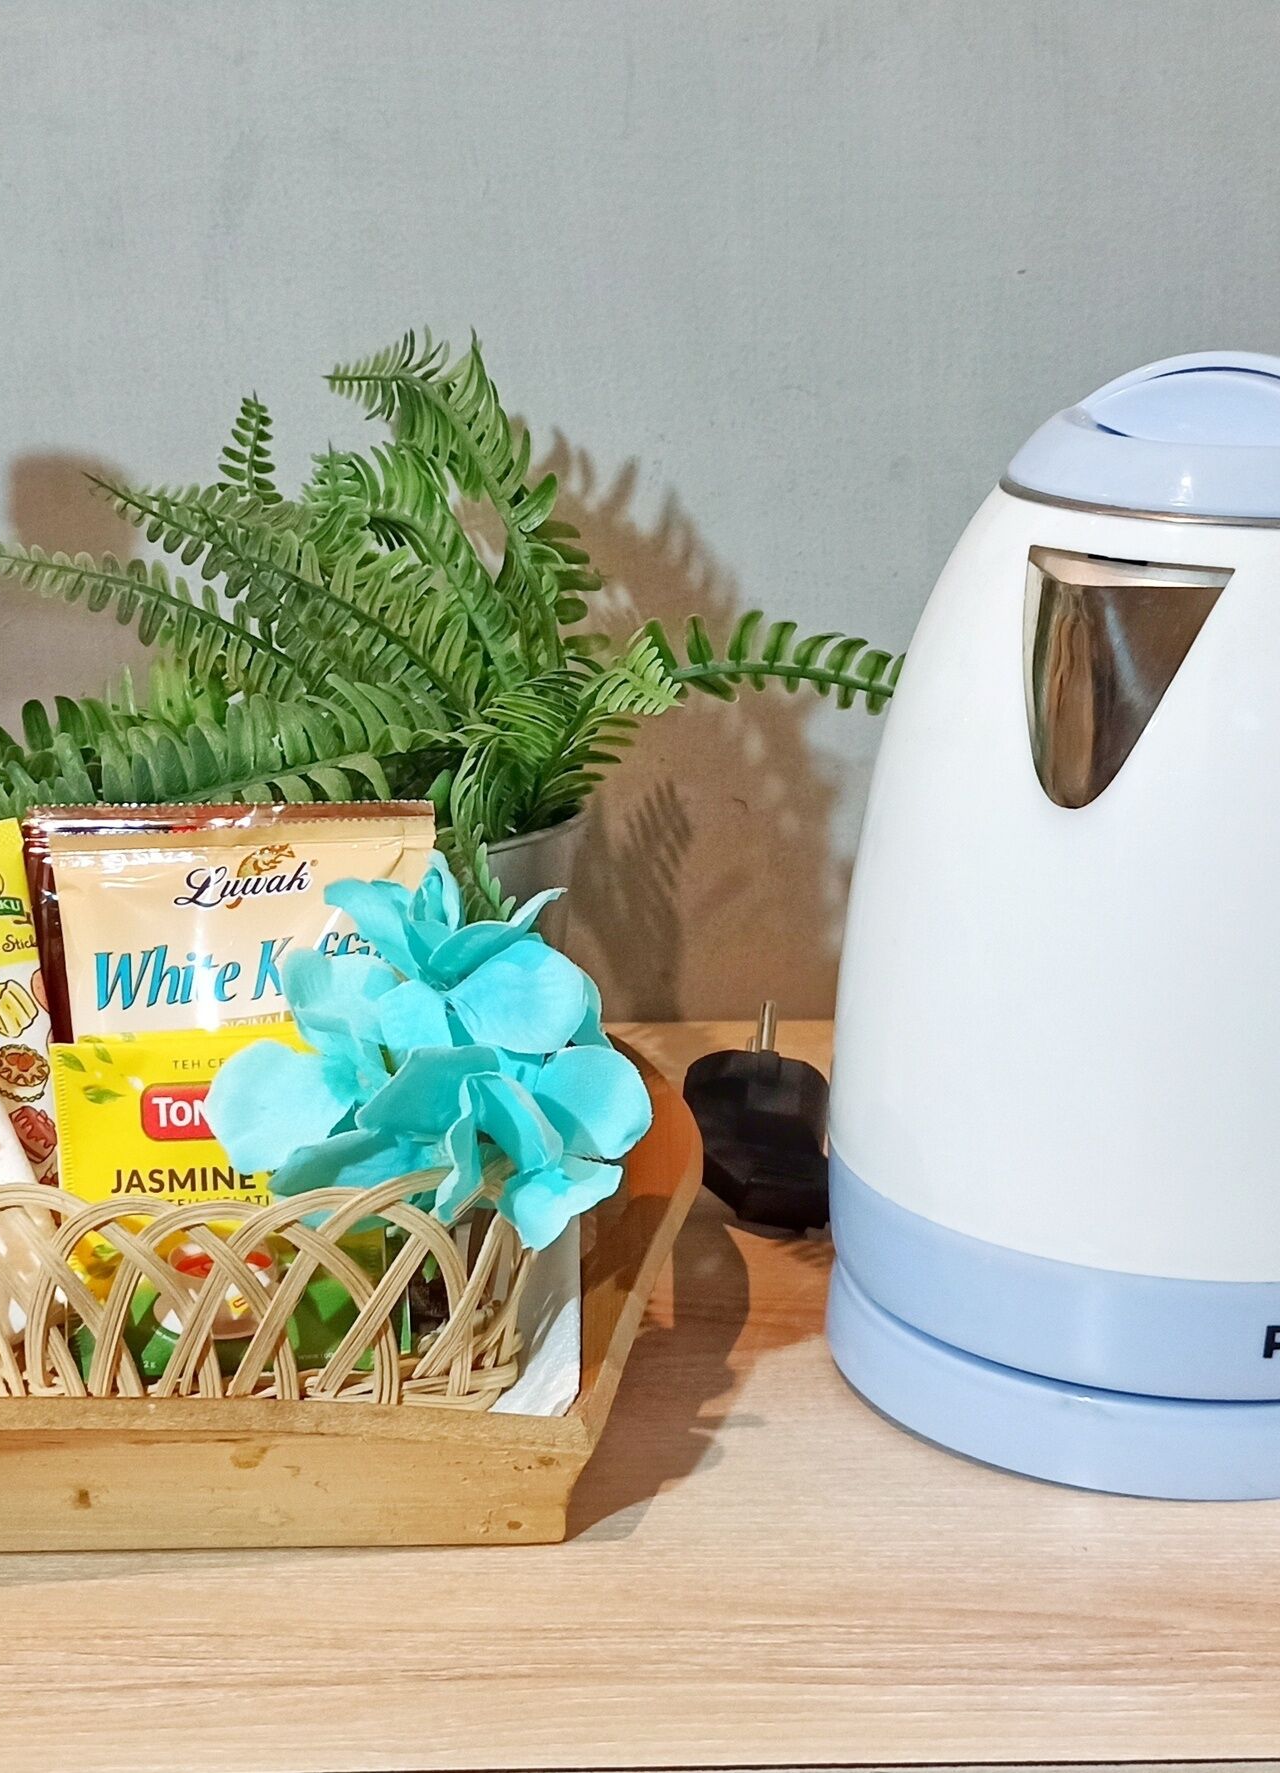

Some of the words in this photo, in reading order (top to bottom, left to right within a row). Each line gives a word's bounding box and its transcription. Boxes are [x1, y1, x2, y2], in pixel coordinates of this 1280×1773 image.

[173, 860, 311, 907] Luwak
[94, 945, 240, 1011] White
[173, 1059, 201, 1070] TEH
[111, 1166, 257, 1194] JASMINE
